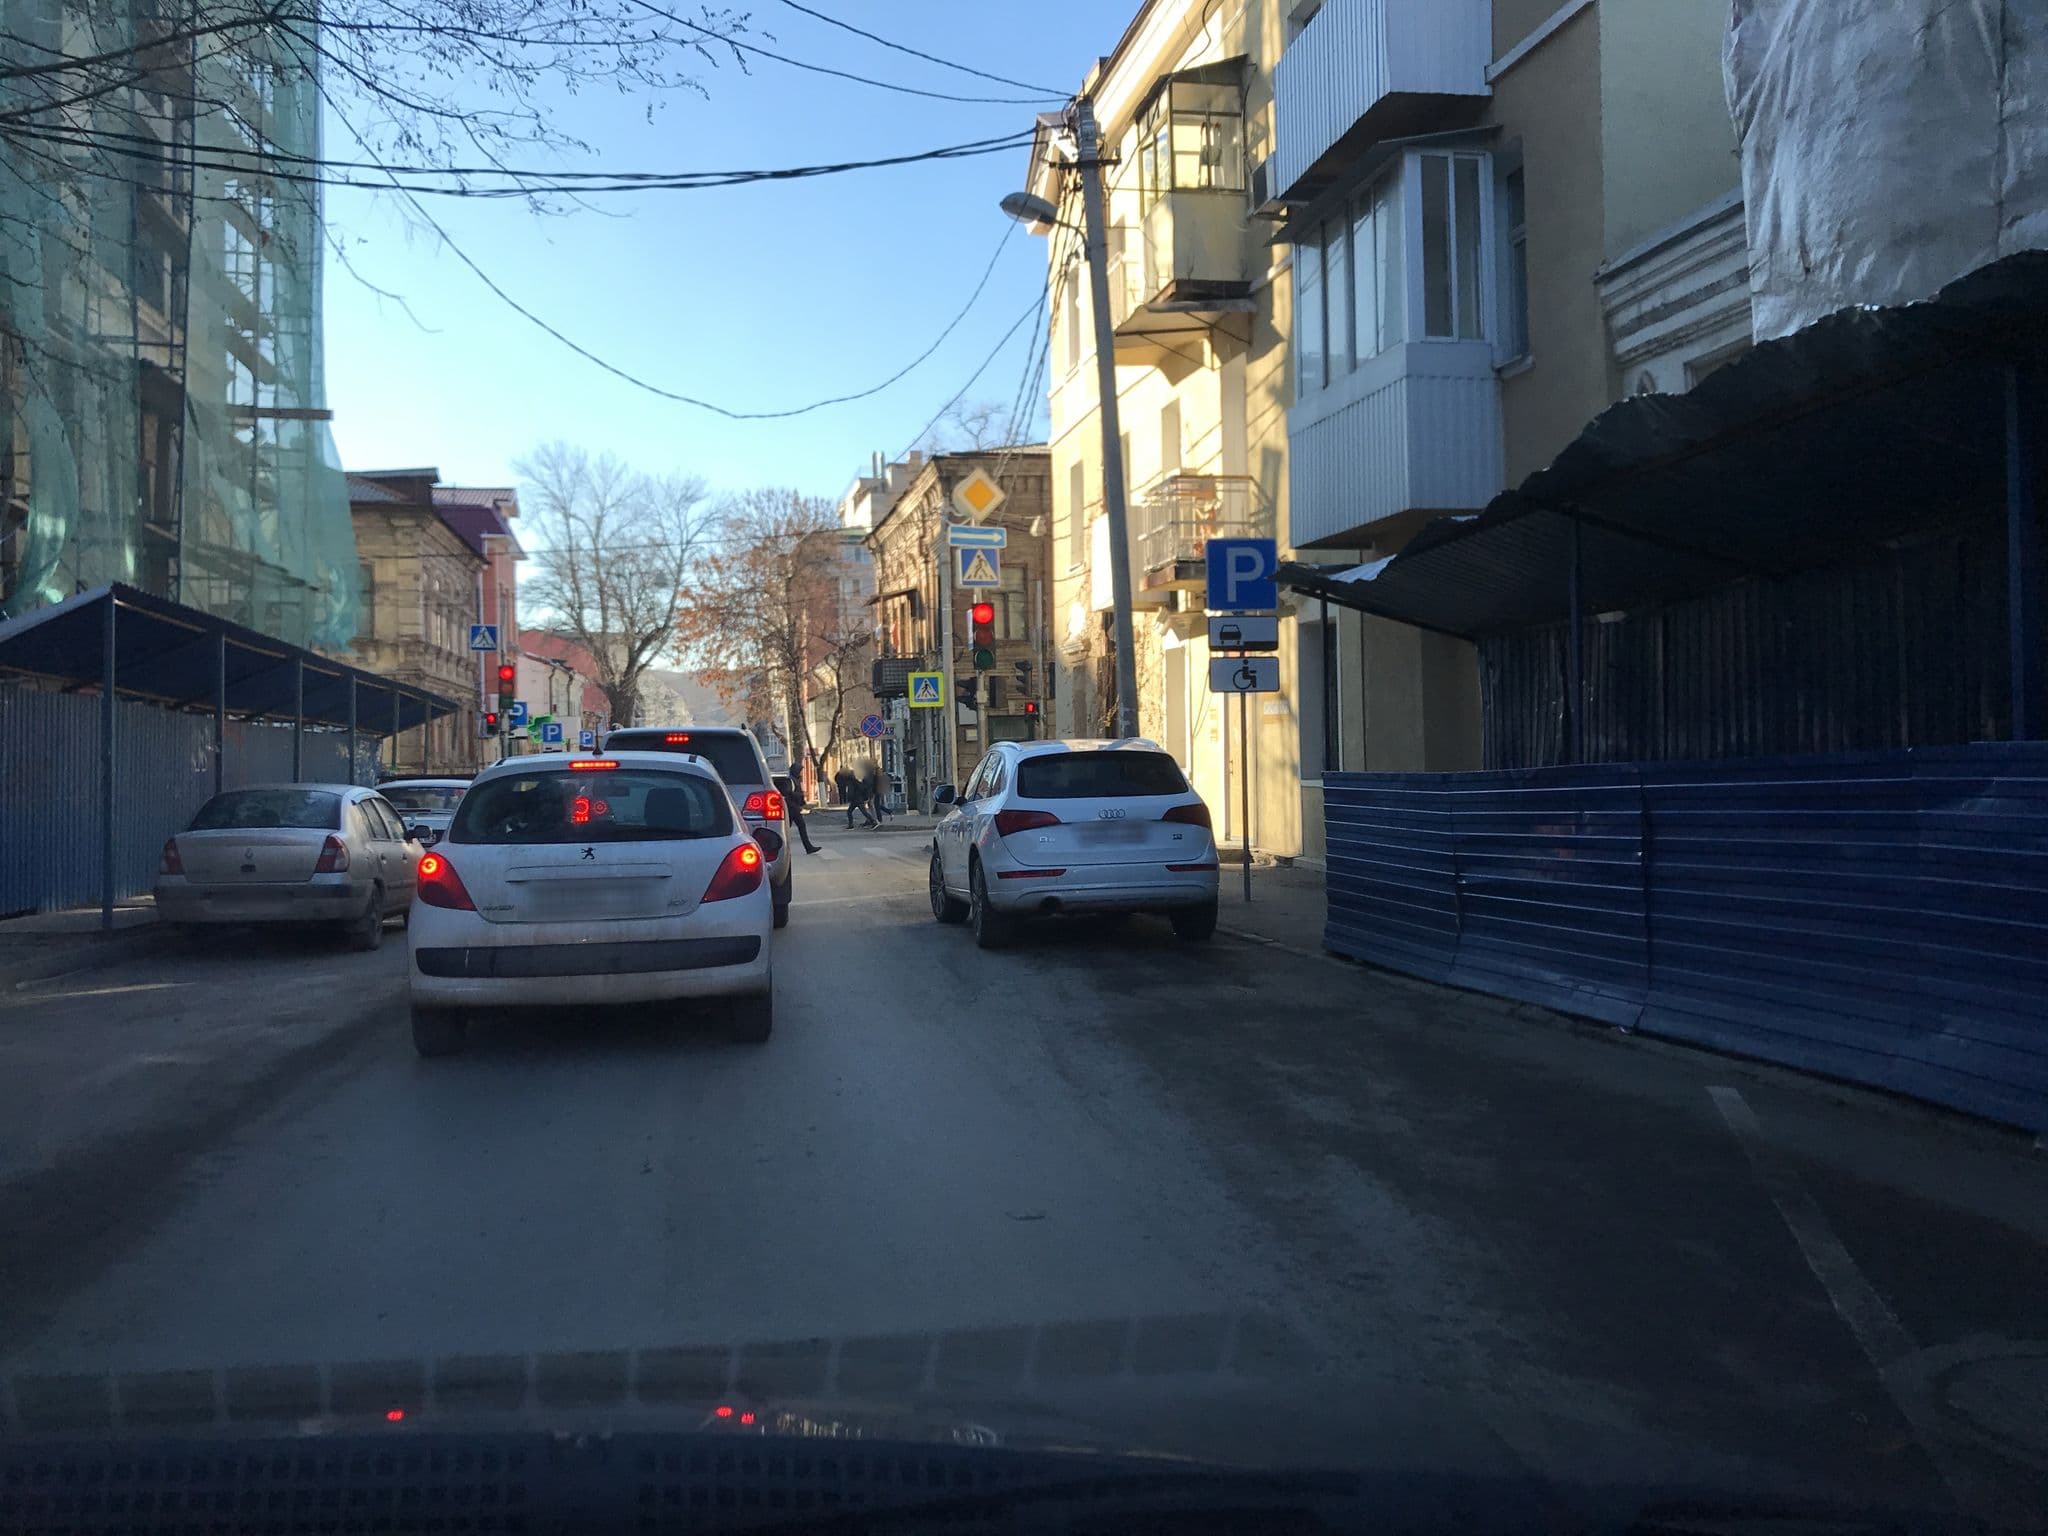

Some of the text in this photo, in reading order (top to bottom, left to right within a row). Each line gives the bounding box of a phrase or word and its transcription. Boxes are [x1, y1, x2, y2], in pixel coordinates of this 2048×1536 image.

[1226, 546, 1265, 603] P
[546, 725, 560, 741] P
[582, 732, 592, 743] P
